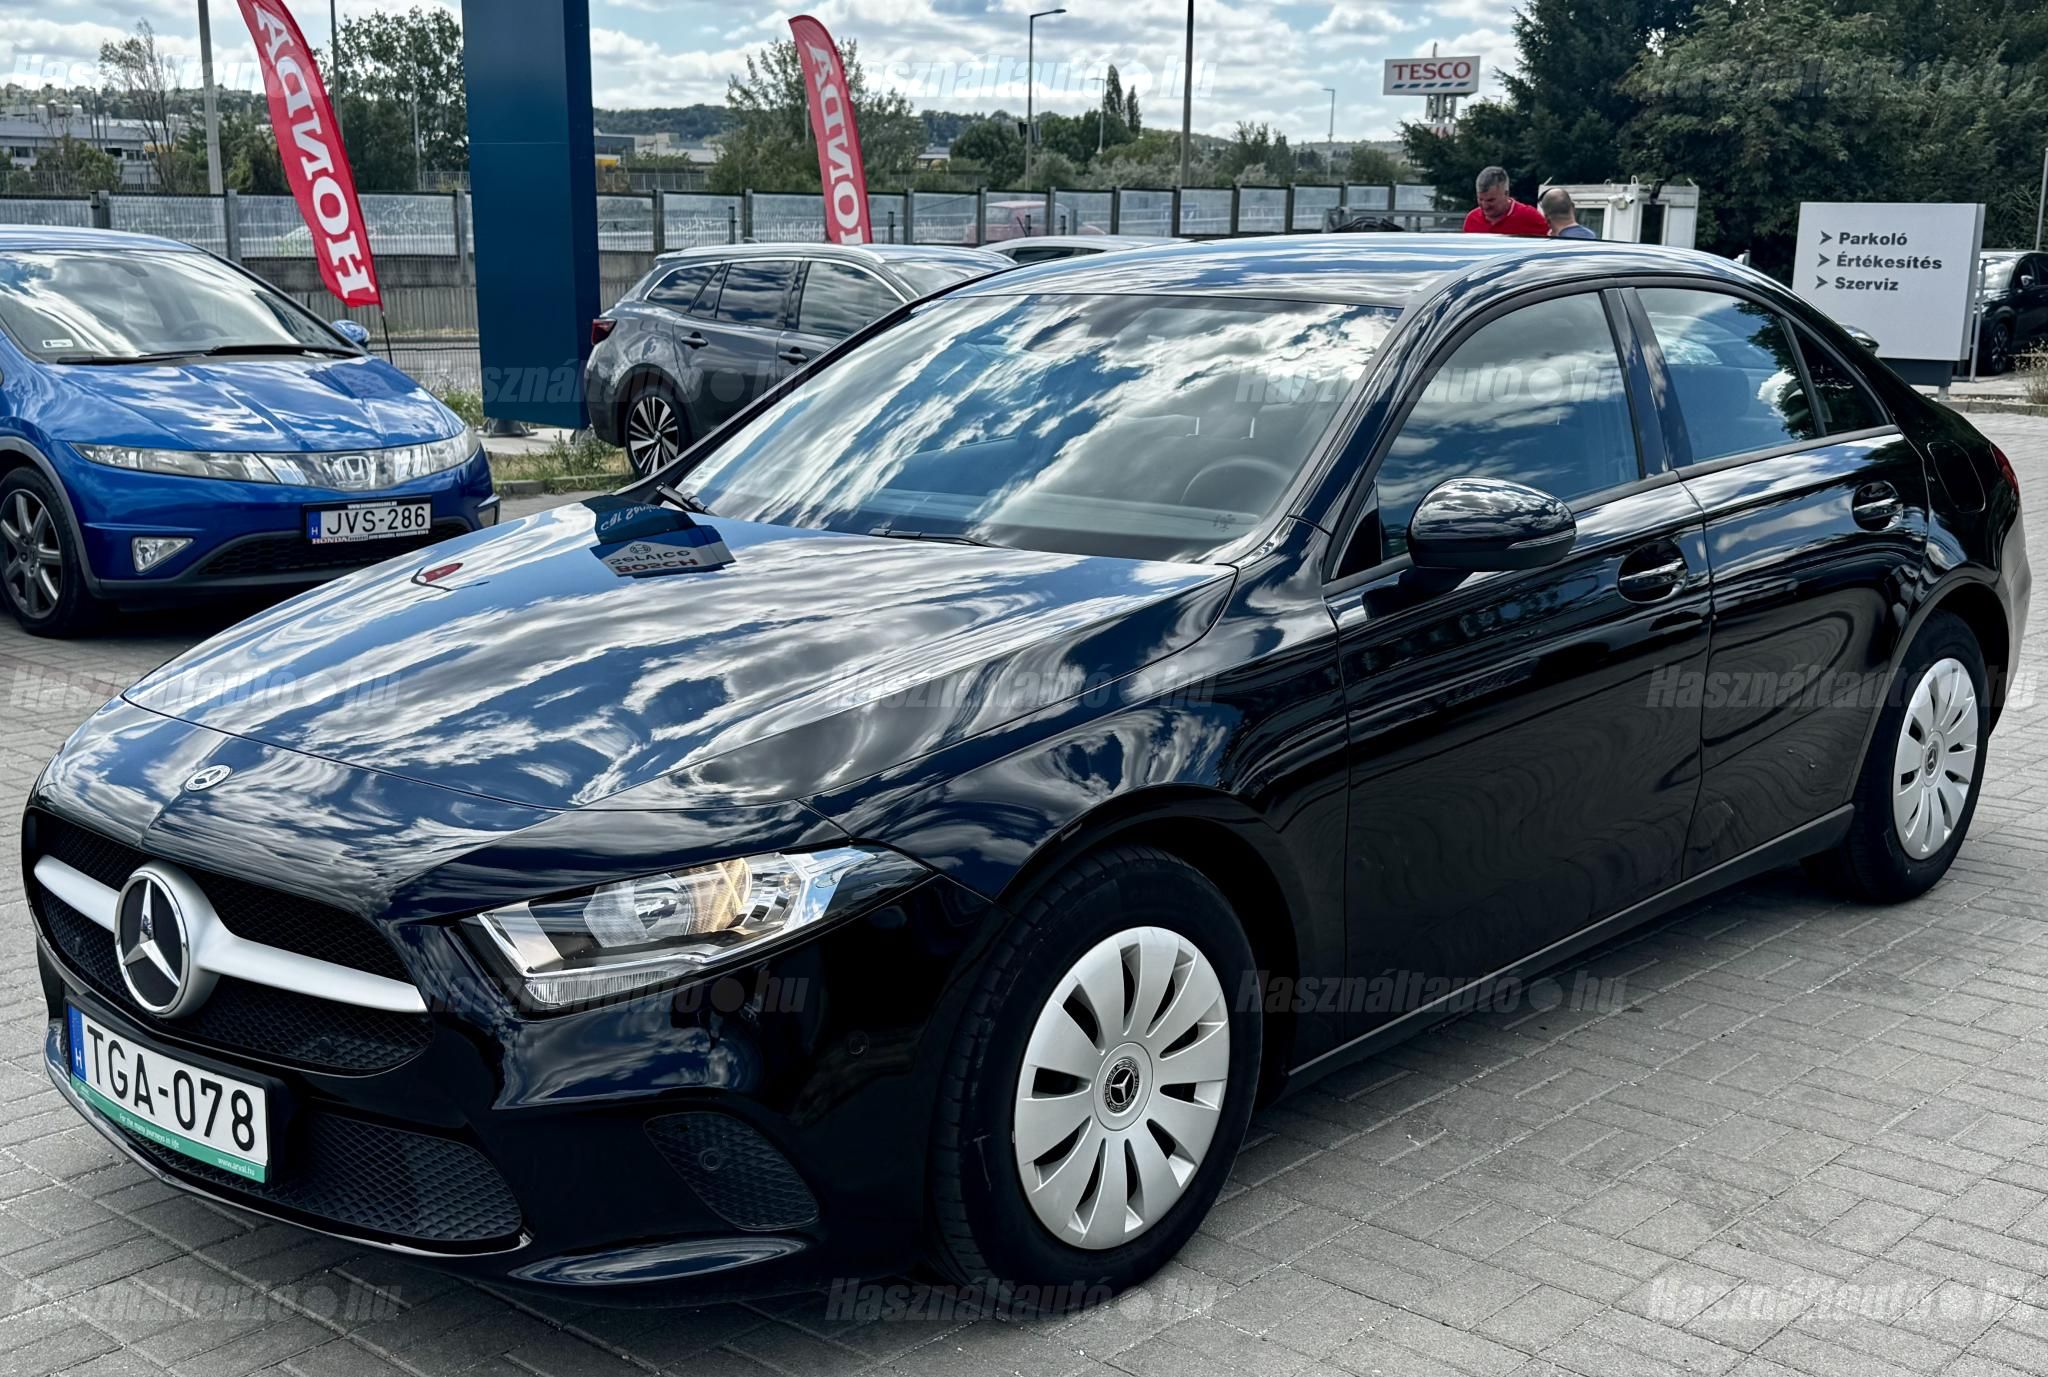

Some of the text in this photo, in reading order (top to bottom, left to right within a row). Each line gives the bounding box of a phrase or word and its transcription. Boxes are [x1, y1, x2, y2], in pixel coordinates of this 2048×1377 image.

[1391, 61, 1472, 81] TESCO
[1838, 231, 1908, 246] Parkoló
[1836, 250, 1943, 270] Értékesítés
[1834, 276, 1900, 292] Szerviz
[326, 506, 426, 535] JVS-286
[87, 1024, 255, 1152] TGA-078
